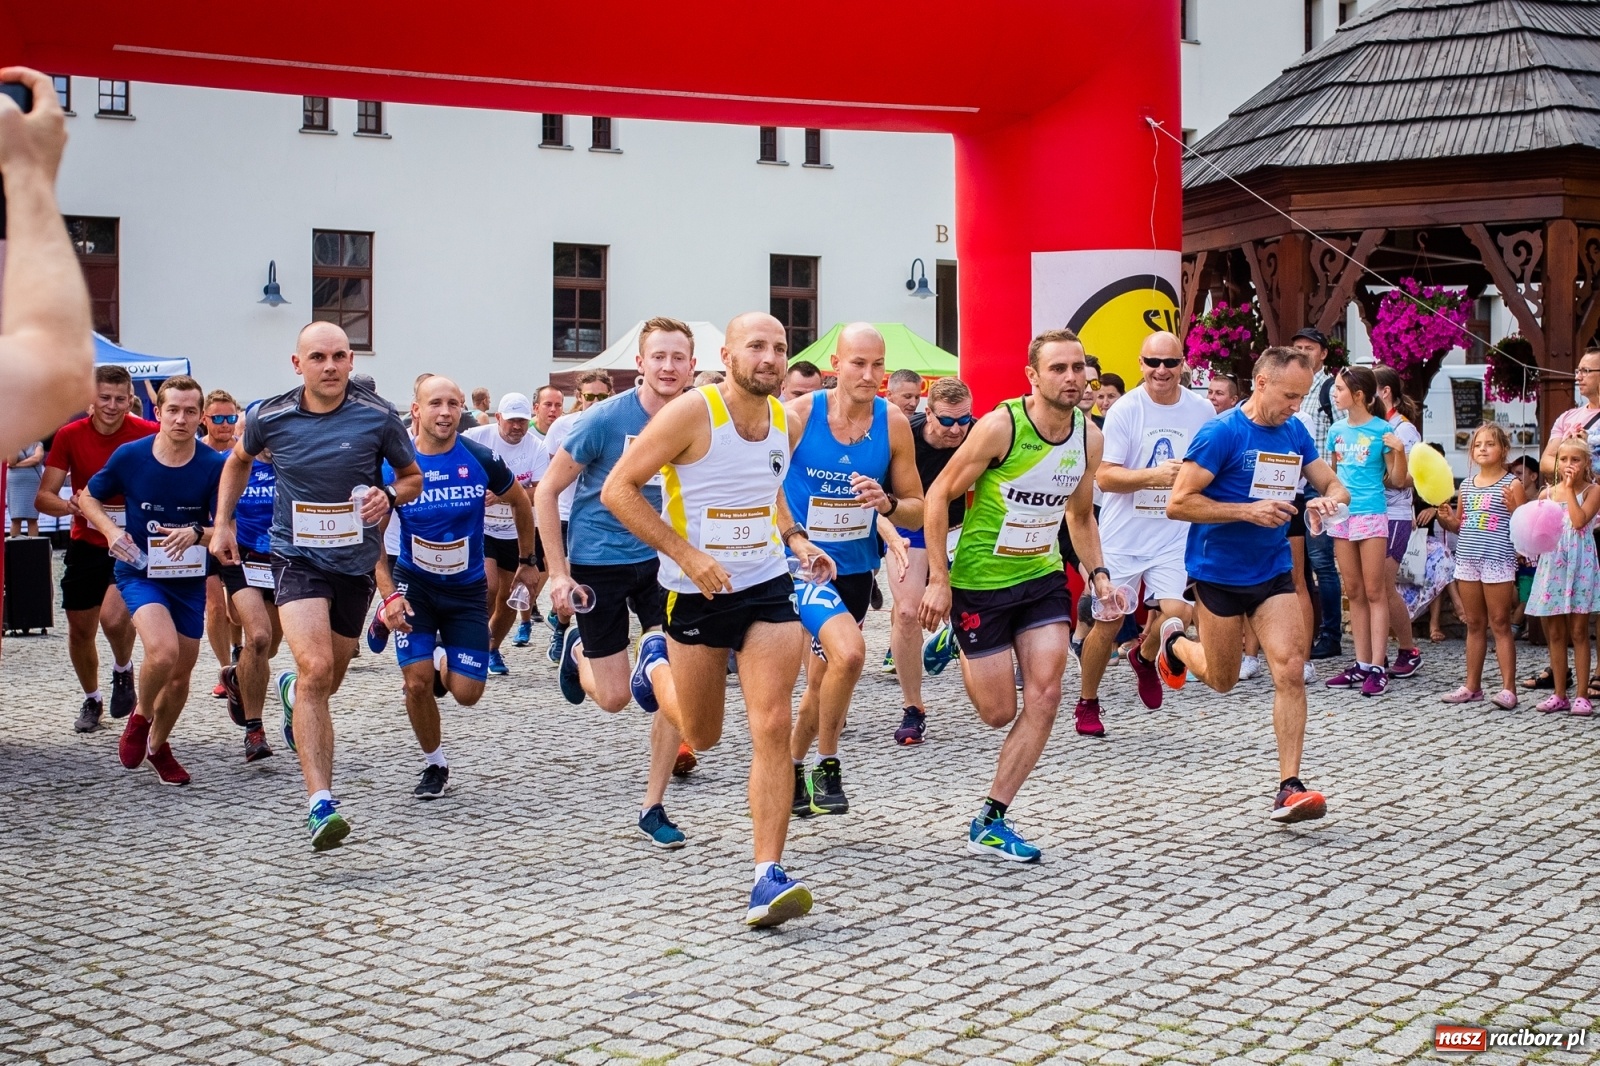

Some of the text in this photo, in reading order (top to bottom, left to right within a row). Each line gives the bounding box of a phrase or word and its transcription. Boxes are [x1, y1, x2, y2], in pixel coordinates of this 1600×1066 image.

[936, 224, 949, 243] B
[126, 364, 160, 374] OWY
[1273, 470, 1286, 482] 36
[1153, 495, 1167, 504] 44
[834, 513, 849, 524] 16
[319, 520, 336, 531] 10
[733, 526, 750, 540] 39
[1025, 532, 1039, 543] 31
[435, 555, 443, 563] 6
